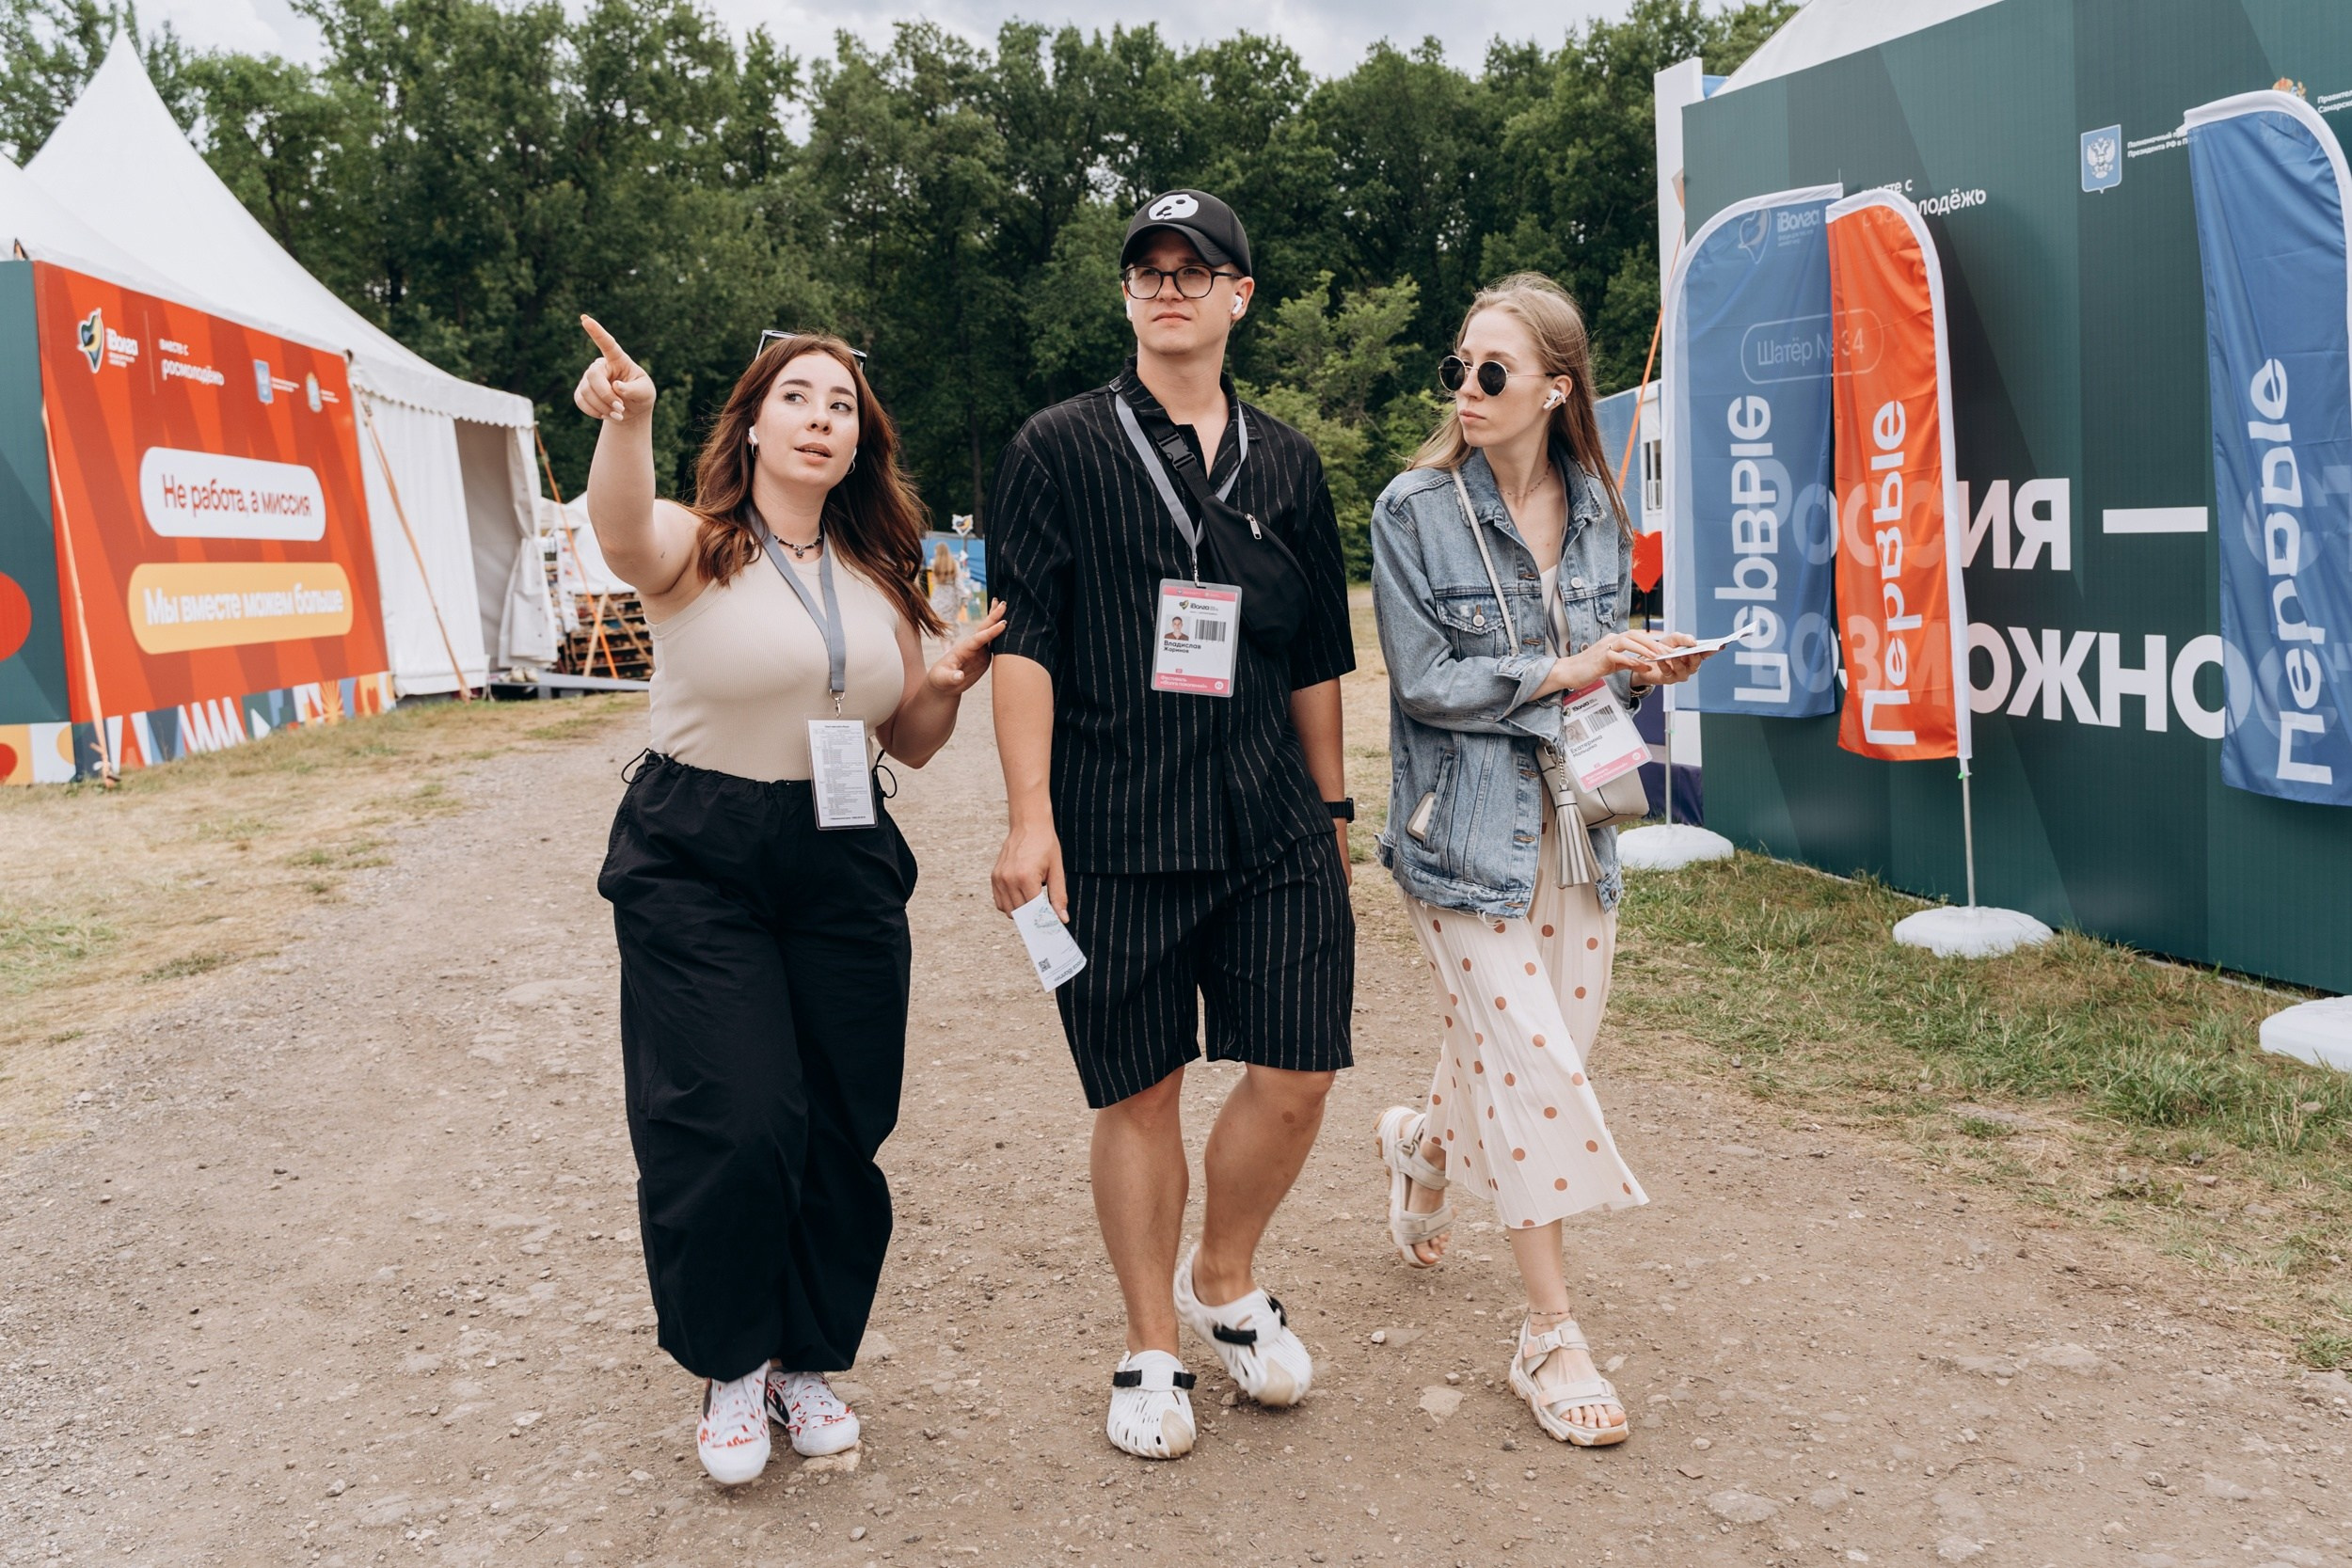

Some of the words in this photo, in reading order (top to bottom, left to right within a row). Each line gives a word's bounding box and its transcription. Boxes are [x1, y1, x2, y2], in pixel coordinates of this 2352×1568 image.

[1756, 335, 1813, 367] Шатёр
[162, 473, 187, 510] Не
[191, 478, 250, 518] работа,
[250, 490, 260, 514] а
[262, 491, 313, 517] миссия
[1862, 400, 1923, 746] Первые
[143, 585, 180, 626] Мы
[180, 591, 243, 625] вместе
[243, 590, 294, 620] можем
[294, 581, 345, 616] больше
[1164, 640, 1201, 649] Владислав
